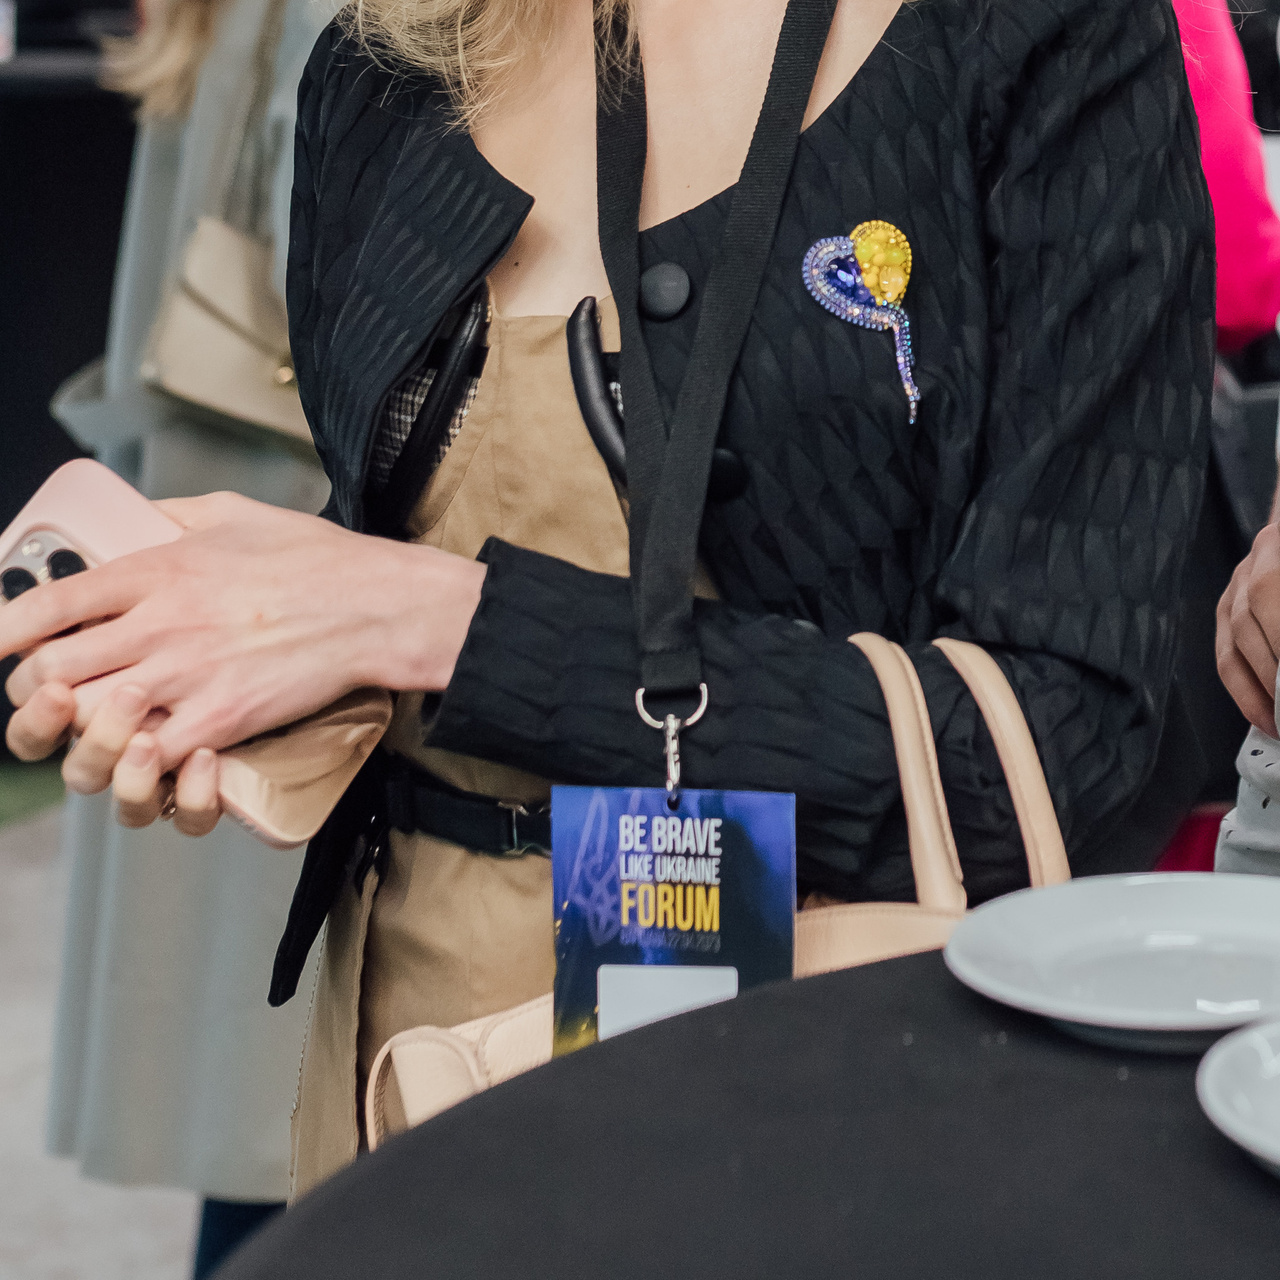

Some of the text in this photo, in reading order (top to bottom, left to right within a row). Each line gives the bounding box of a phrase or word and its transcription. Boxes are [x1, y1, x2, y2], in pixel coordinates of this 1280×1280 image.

[619, 814, 723, 856] BE BRAVE
[619, 853, 721, 886] LIKE UKRAINE
[621, 882, 721, 932] FORUM
